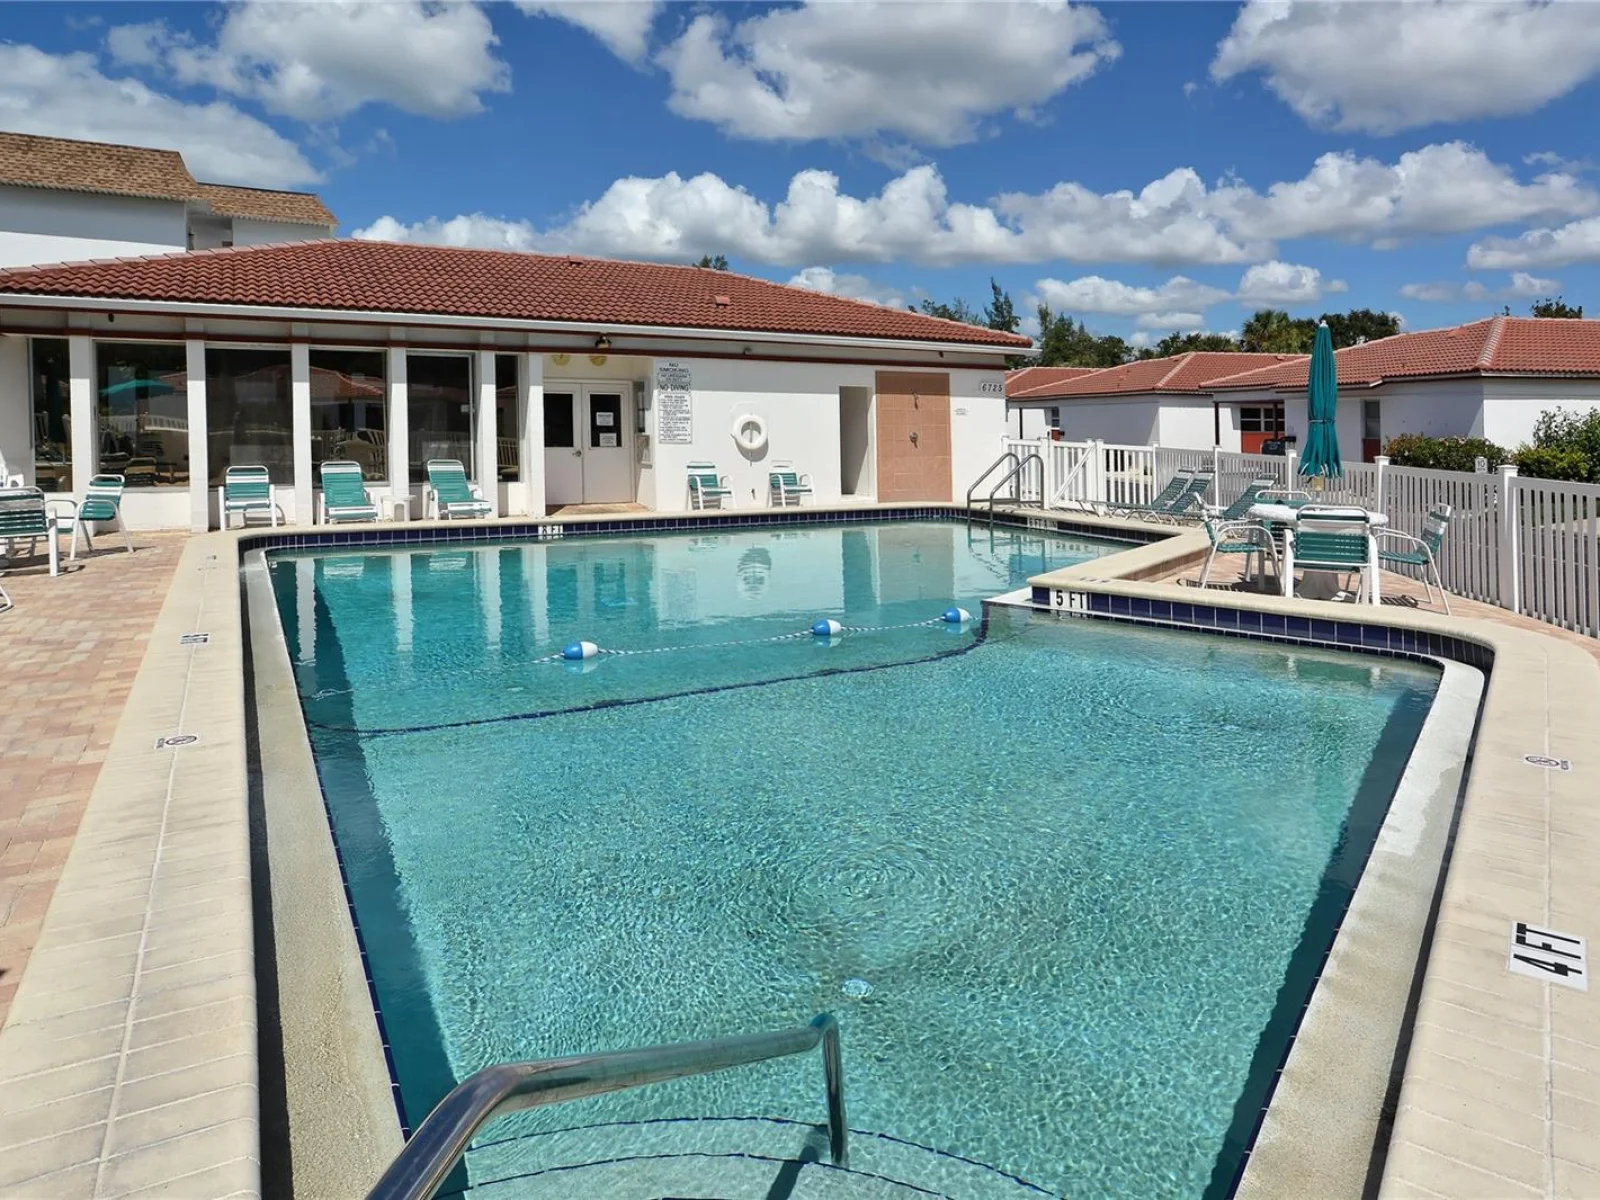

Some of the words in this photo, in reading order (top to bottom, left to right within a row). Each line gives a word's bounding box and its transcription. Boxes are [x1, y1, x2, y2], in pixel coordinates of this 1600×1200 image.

[671, 384, 689, 392] DIVING
[982, 383, 1003, 393] 6725
[1056, 589, 1064, 606] 5
[1069, 591, 1085, 609] FT
[1516, 922, 1582, 960] FT
[1513, 953, 1583, 977] 4
